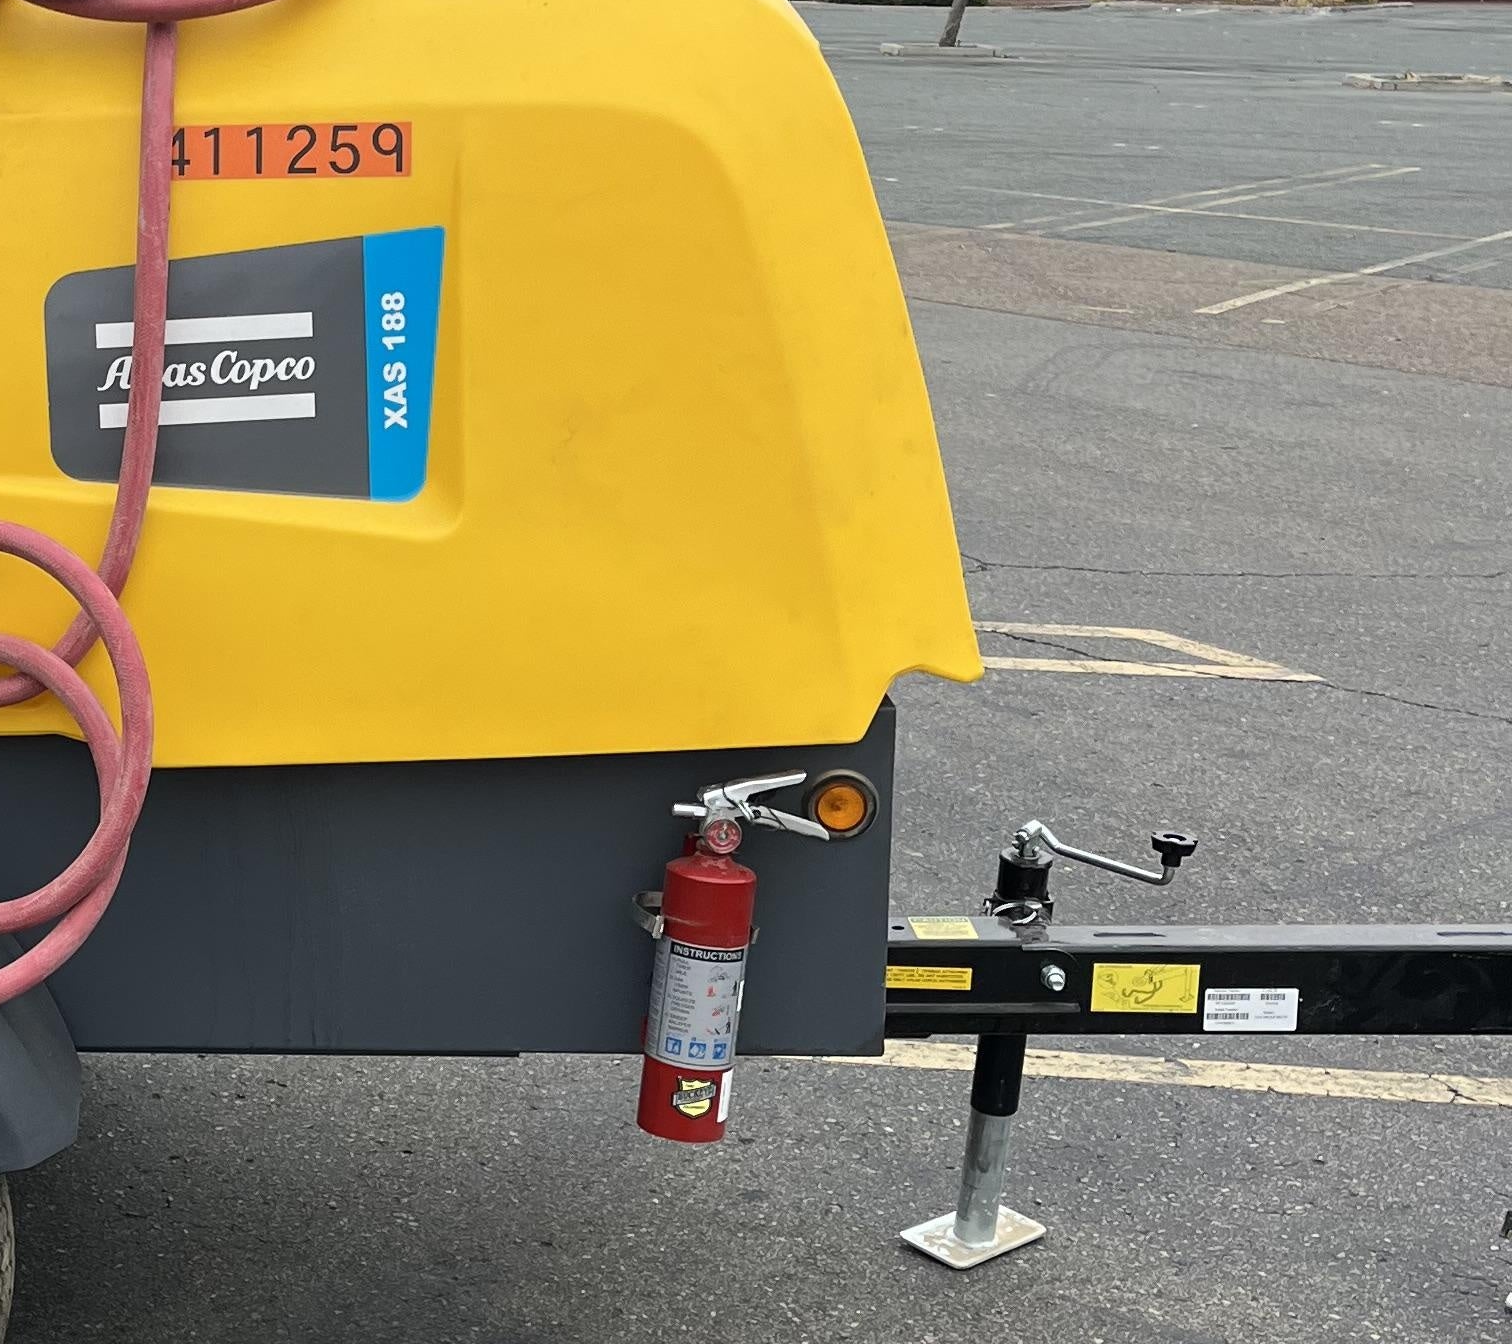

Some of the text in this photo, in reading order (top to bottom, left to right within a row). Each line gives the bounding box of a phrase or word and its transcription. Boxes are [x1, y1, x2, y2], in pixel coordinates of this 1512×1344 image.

[96, 350, 316, 392] Aas Copco
[381, 291, 408, 430] XAS 188
